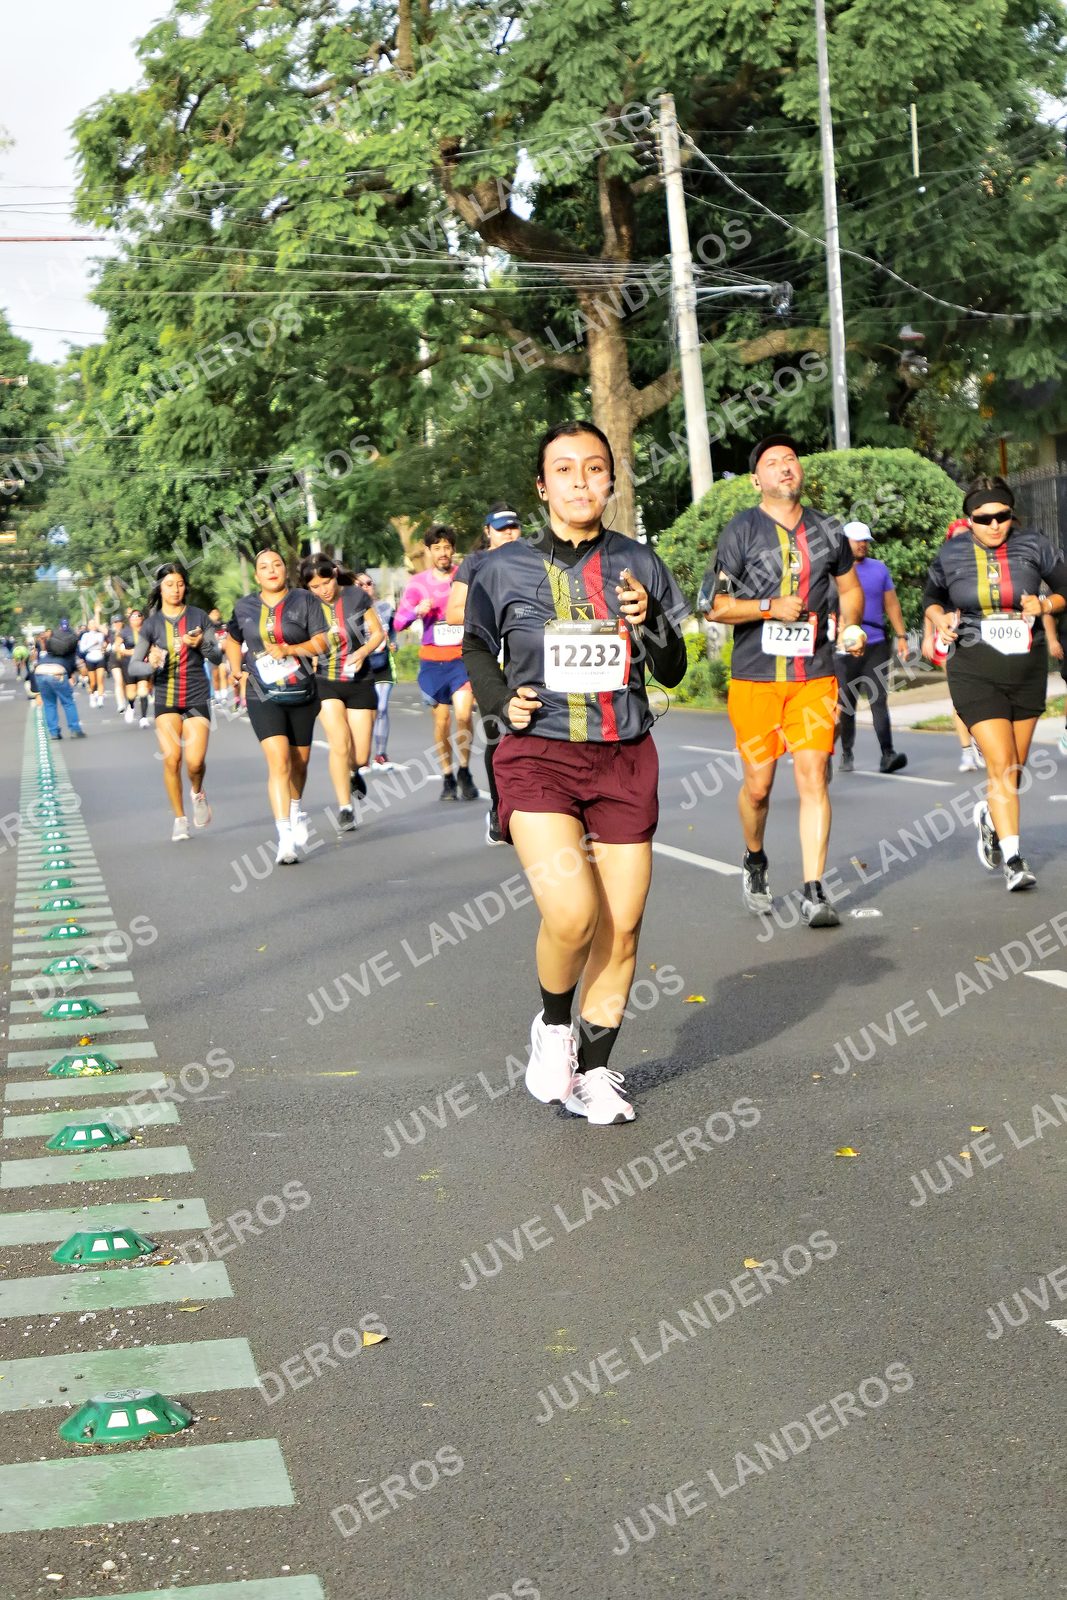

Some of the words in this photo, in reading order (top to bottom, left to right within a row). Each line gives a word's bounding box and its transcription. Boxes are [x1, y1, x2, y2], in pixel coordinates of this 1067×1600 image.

[768, 626, 810, 641] 12272
[989, 626, 1022, 639] 9096
[550, 644, 621, 667] 12232
